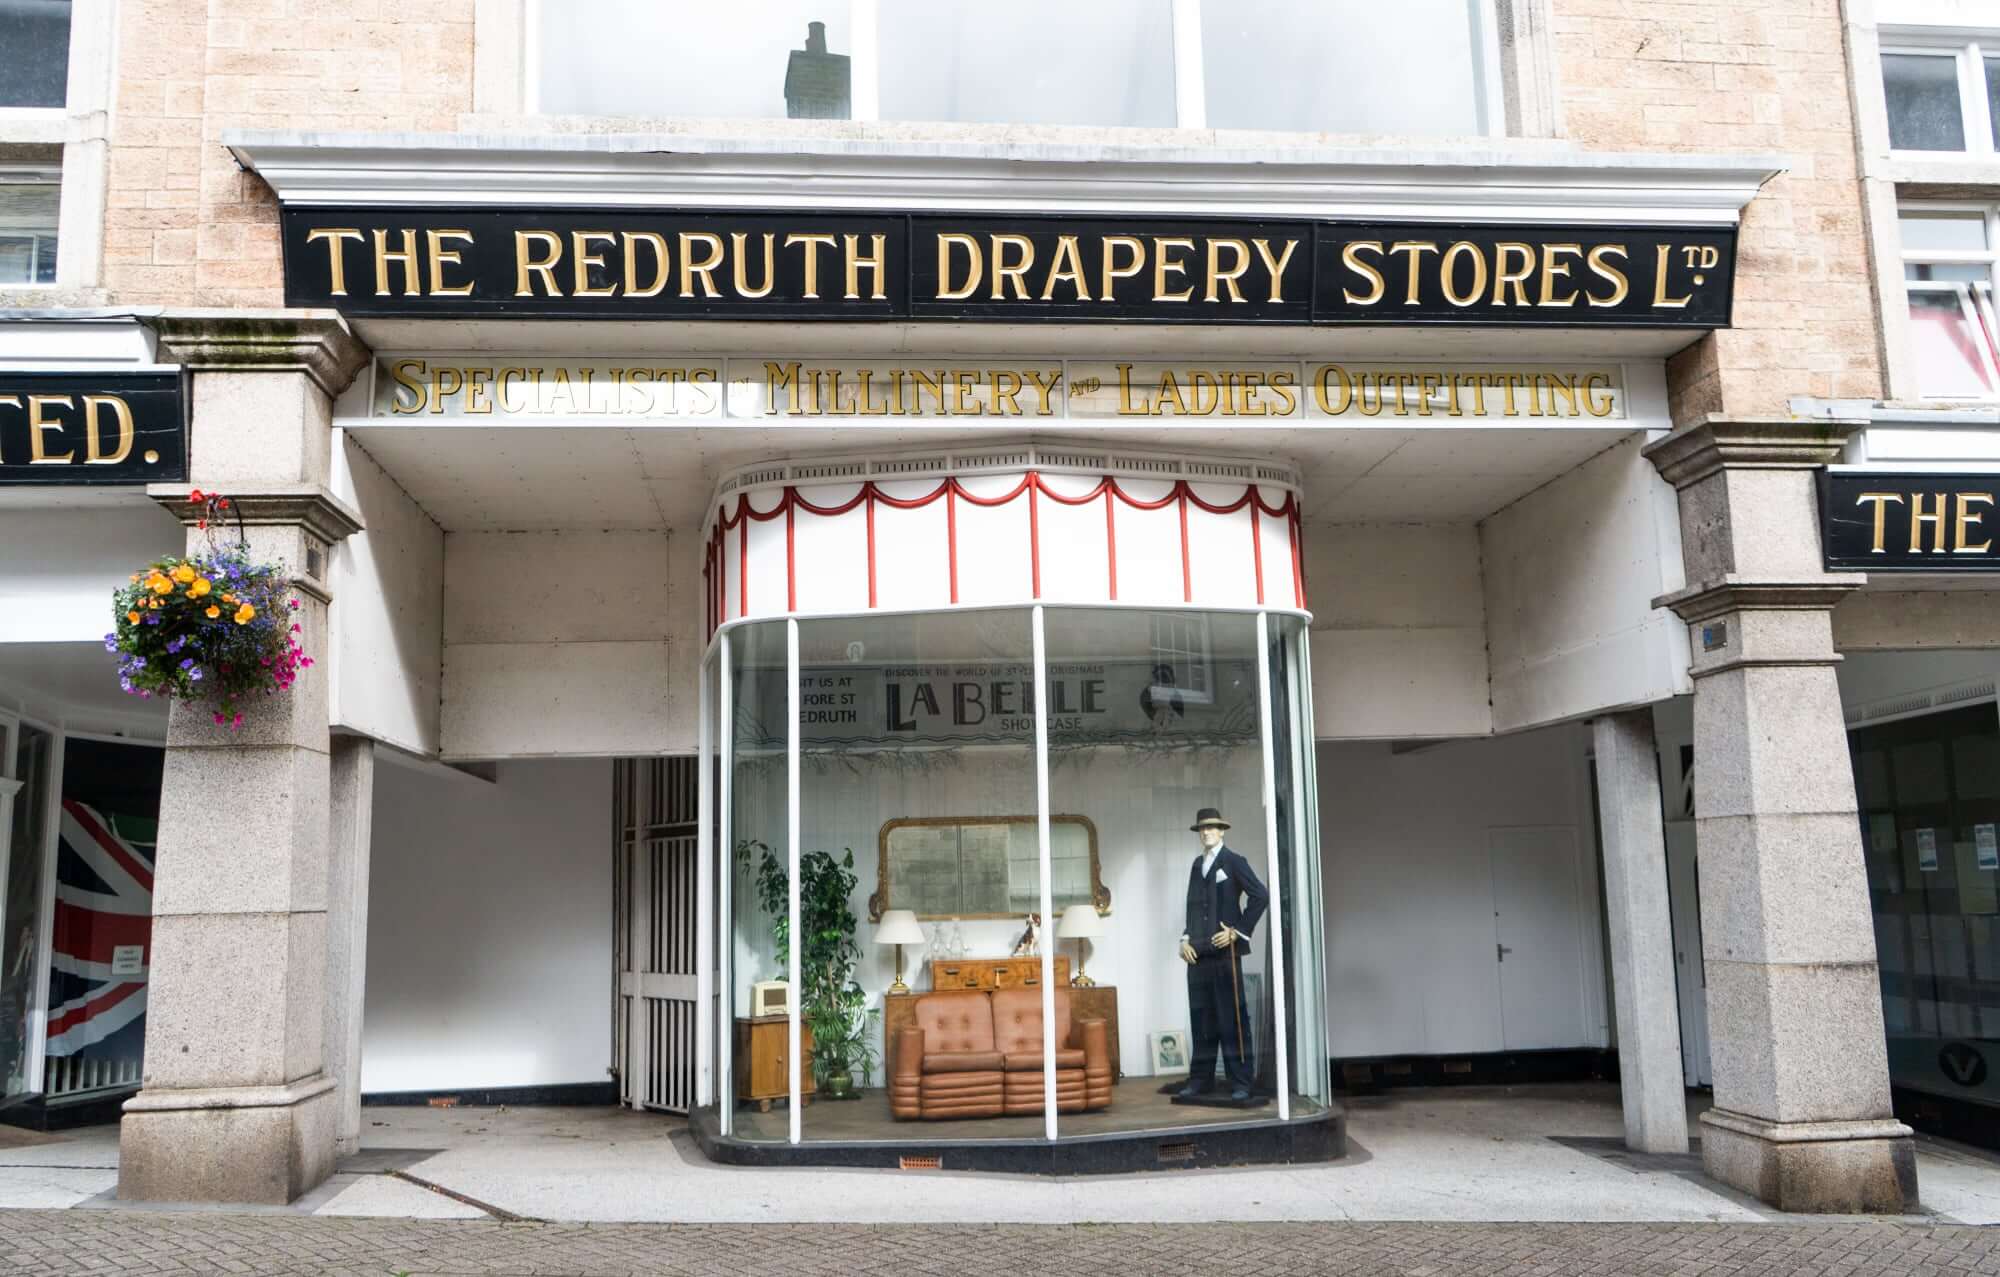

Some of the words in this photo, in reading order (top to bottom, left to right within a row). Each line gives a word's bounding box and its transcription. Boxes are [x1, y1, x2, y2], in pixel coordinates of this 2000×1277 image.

[306, 228, 475, 297] THE
[514, 229, 888, 299] REDRUTH
[936, 232, 1300, 304] DRAPERY
[1340, 239, 1630, 309] STORES
[391, 358, 718, 416] SPECIALISTS
[762, 360, 1063, 416] MILLINERY
[1069, 376, 1101, 398] AND
[1114, 362, 1295, 416] LADIES
[1313, 364, 1614, 417] OUTFITTING
[1855, 491, 1995, 554] THE
[819, 676, 834, 688] US
[838, 675, 854, 687] AT
[803, 693, 836, 706] FORE
[841, 692, 857, 705] ST
[886, 682, 941, 731] LA
[799, 709, 857, 723] EDRUTH
[1000, 716, 1082, 732] SHOCASE
